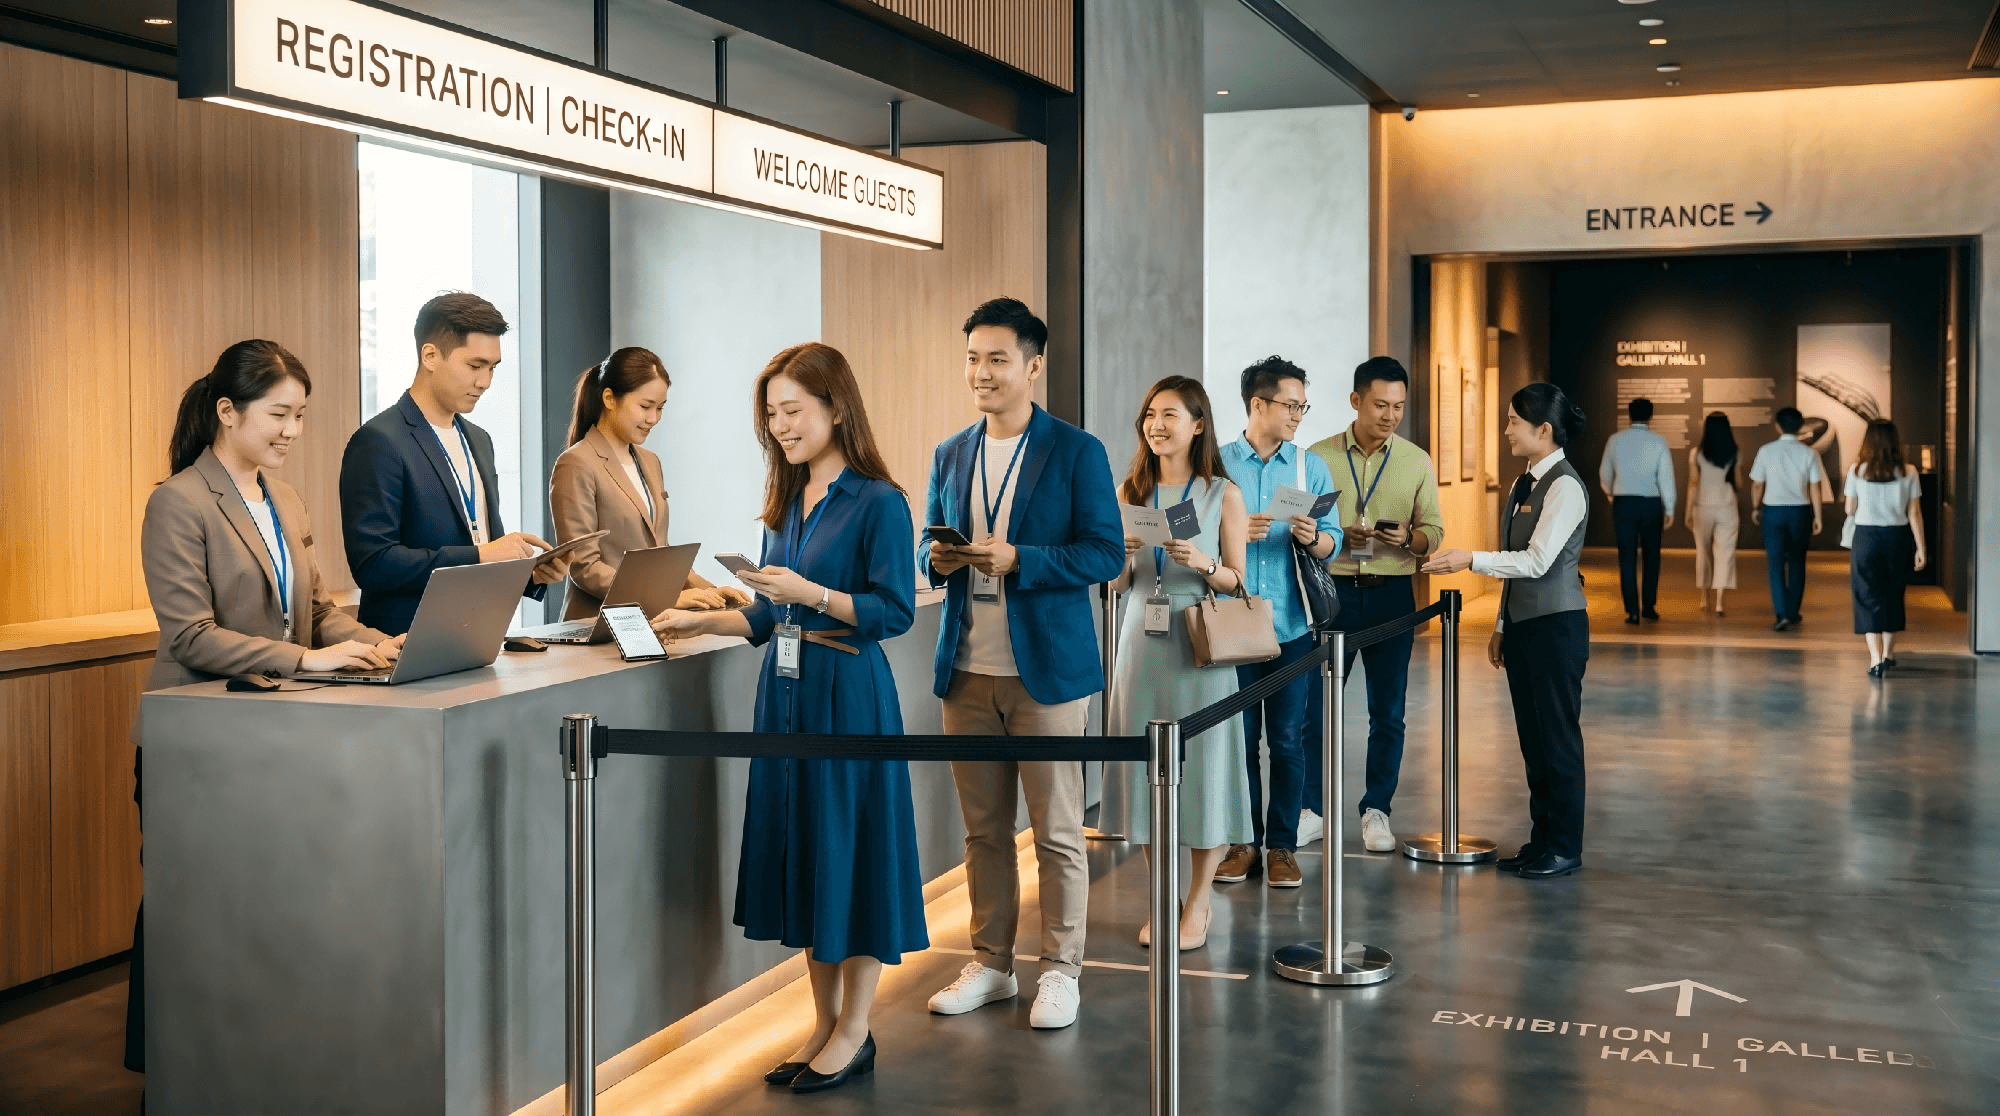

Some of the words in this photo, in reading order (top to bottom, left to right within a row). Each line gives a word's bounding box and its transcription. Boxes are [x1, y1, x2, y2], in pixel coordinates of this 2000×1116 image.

[276, 16, 534, 125] REGISTRATION
[561, 95, 686, 162] CHECK-IN
[753, 147, 848, 200] WELCOME
[853, 175, 917, 217] GUESTS
[1586, 203, 1735, 231] ENTRANCE
[1616, 354, 1667, 366] GALLERY
[1668, 354, 1698, 366] HALL
[1699, 353, 1706, 366] 1
[1431, 1010, 1671, 1044] EXHIBITION
[1600, 1045, 1715, 1070] HALL
[1732, 1058, 1748, 1073] 1
